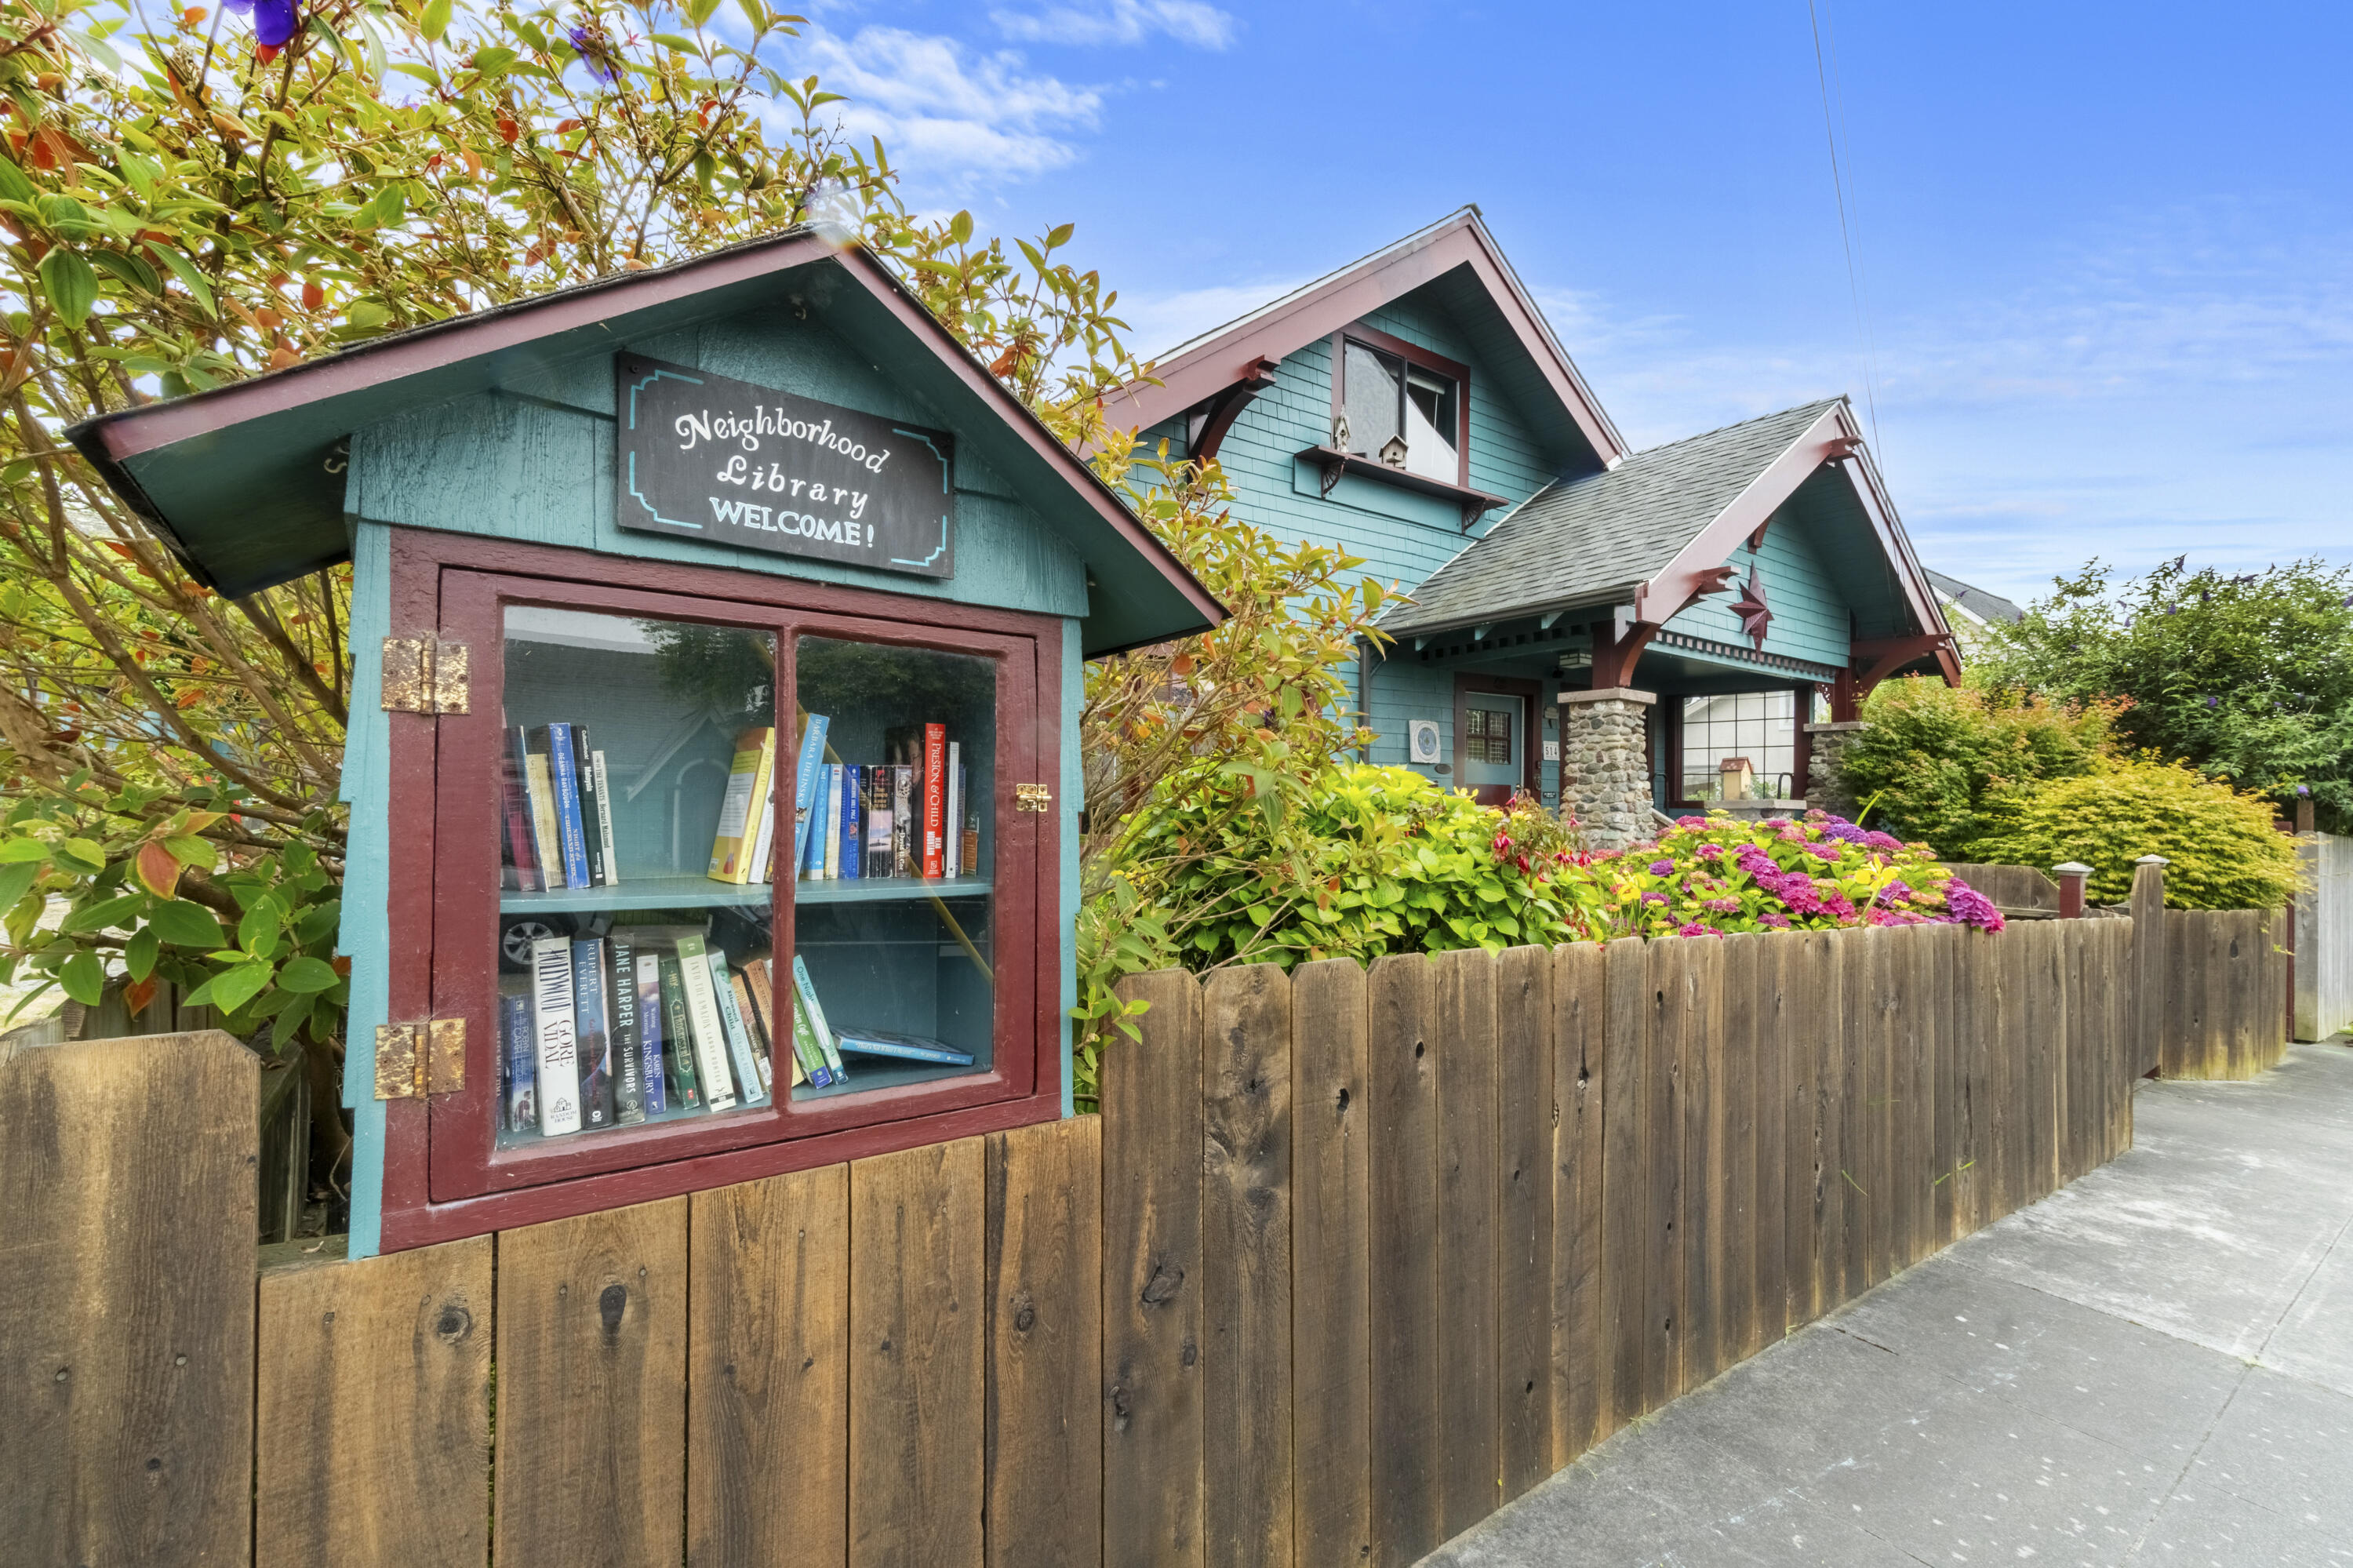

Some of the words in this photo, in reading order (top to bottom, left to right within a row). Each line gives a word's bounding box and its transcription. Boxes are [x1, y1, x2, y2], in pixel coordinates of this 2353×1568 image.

[675, 406, 890, 473] Neighborhood
[717, 455, 868, 519] Library
[709, 497, 875, 548] WELCOME!
[808, 719, 822, 759] BARBARA
[1545, 746, 1557, 755] 514
[584, 766, 592, 791] Malaysia
[931, 743, 941, 783] PRESTON
[797, 761, 812, 804] DELINSKY
[931, 784, 939, 793] &
[930, 795, 939, 827] CHILD
[926, 831, 935, 856] MOUNTAIN
[587, 944, 598, 994] RUPERT
[615, 944, 631, 973] JANE
[690, 960, 702, 980] INTO
[797, 966, 806, 981] One
[537, 948, 571, 1013] HOLLYWOOD
[579, 961, 589, 1014] EVERETT
[695, 982, 704, 996] THE
[616, 979, 633, 1027] HARPER
[698, 999, 711, 1029] AMAZON
[726, 1006, 736, 1030] Child
[727, 990, 740, 1023] Blessed
[514, 1028, 522, 1053] CARR
[544, 1021, 560, 1069] VIDAL
[558, 1020, 574, 1068] GORE
[624, 1046, 635, 1093] SURVIVORS
[643, 1040, 654, 1094] KINGSBURY
[653, 1054, 661, 1078] KAREN
